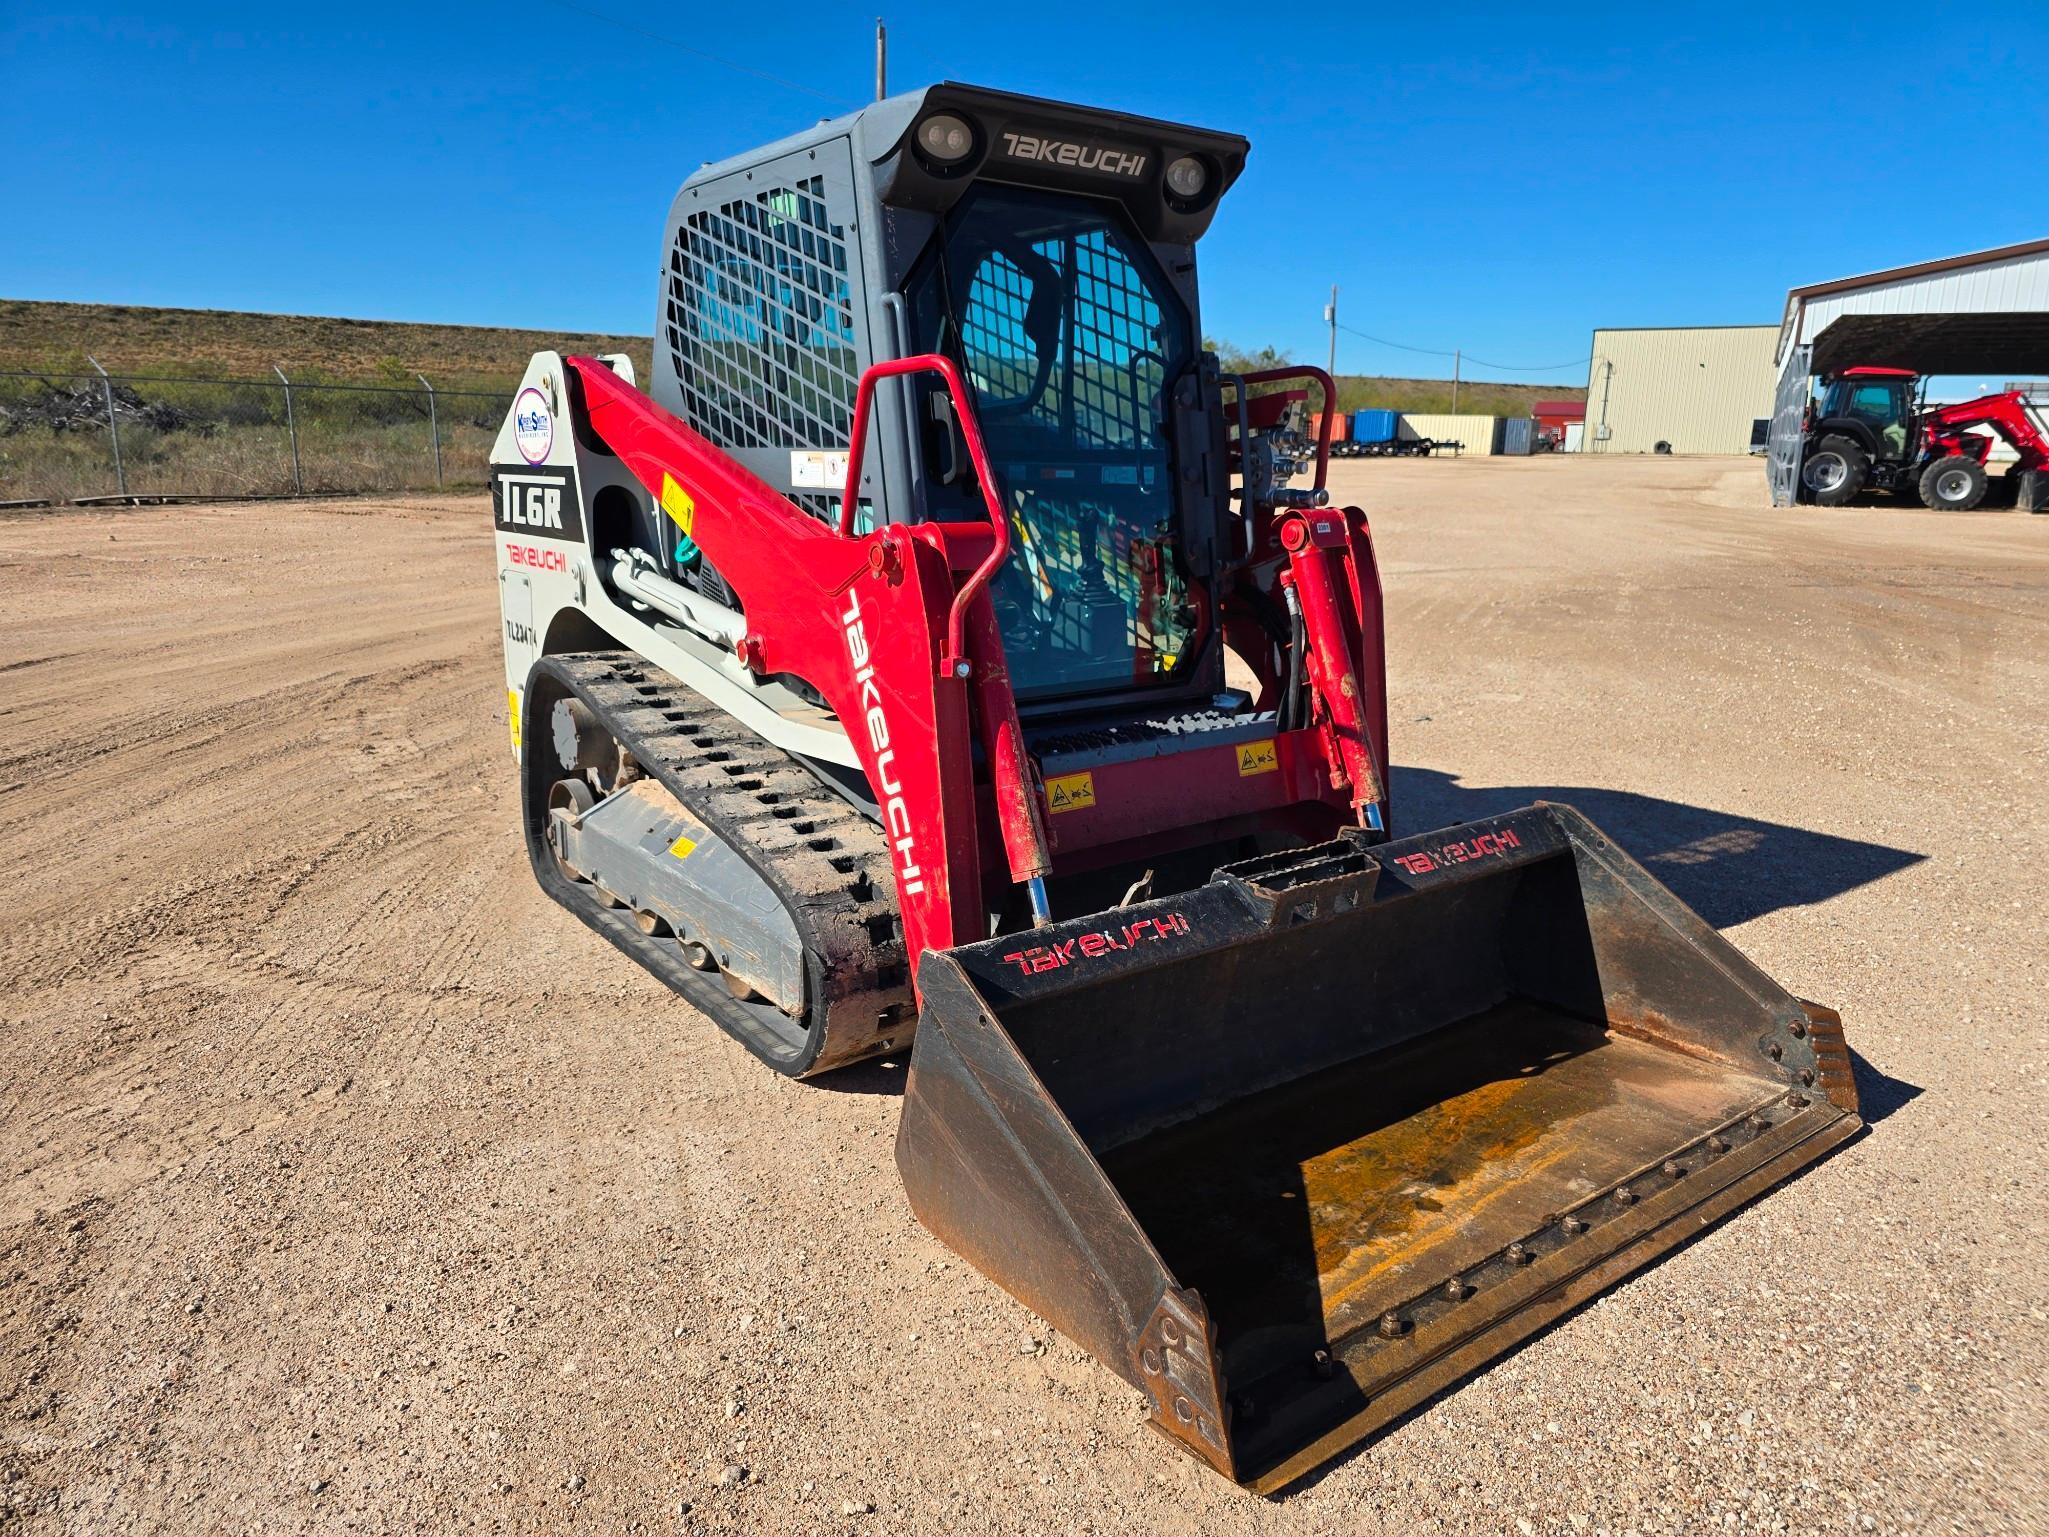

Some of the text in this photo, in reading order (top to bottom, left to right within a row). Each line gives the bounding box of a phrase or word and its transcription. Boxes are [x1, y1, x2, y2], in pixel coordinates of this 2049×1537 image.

[1003, 132, 1147, 177] TAKEUCHI
[497, 473, 566, 530] TL6R
[506, 544, 567, 573] TAKEUCHI
[843, 587, 924, 896] TAKEUCHI
